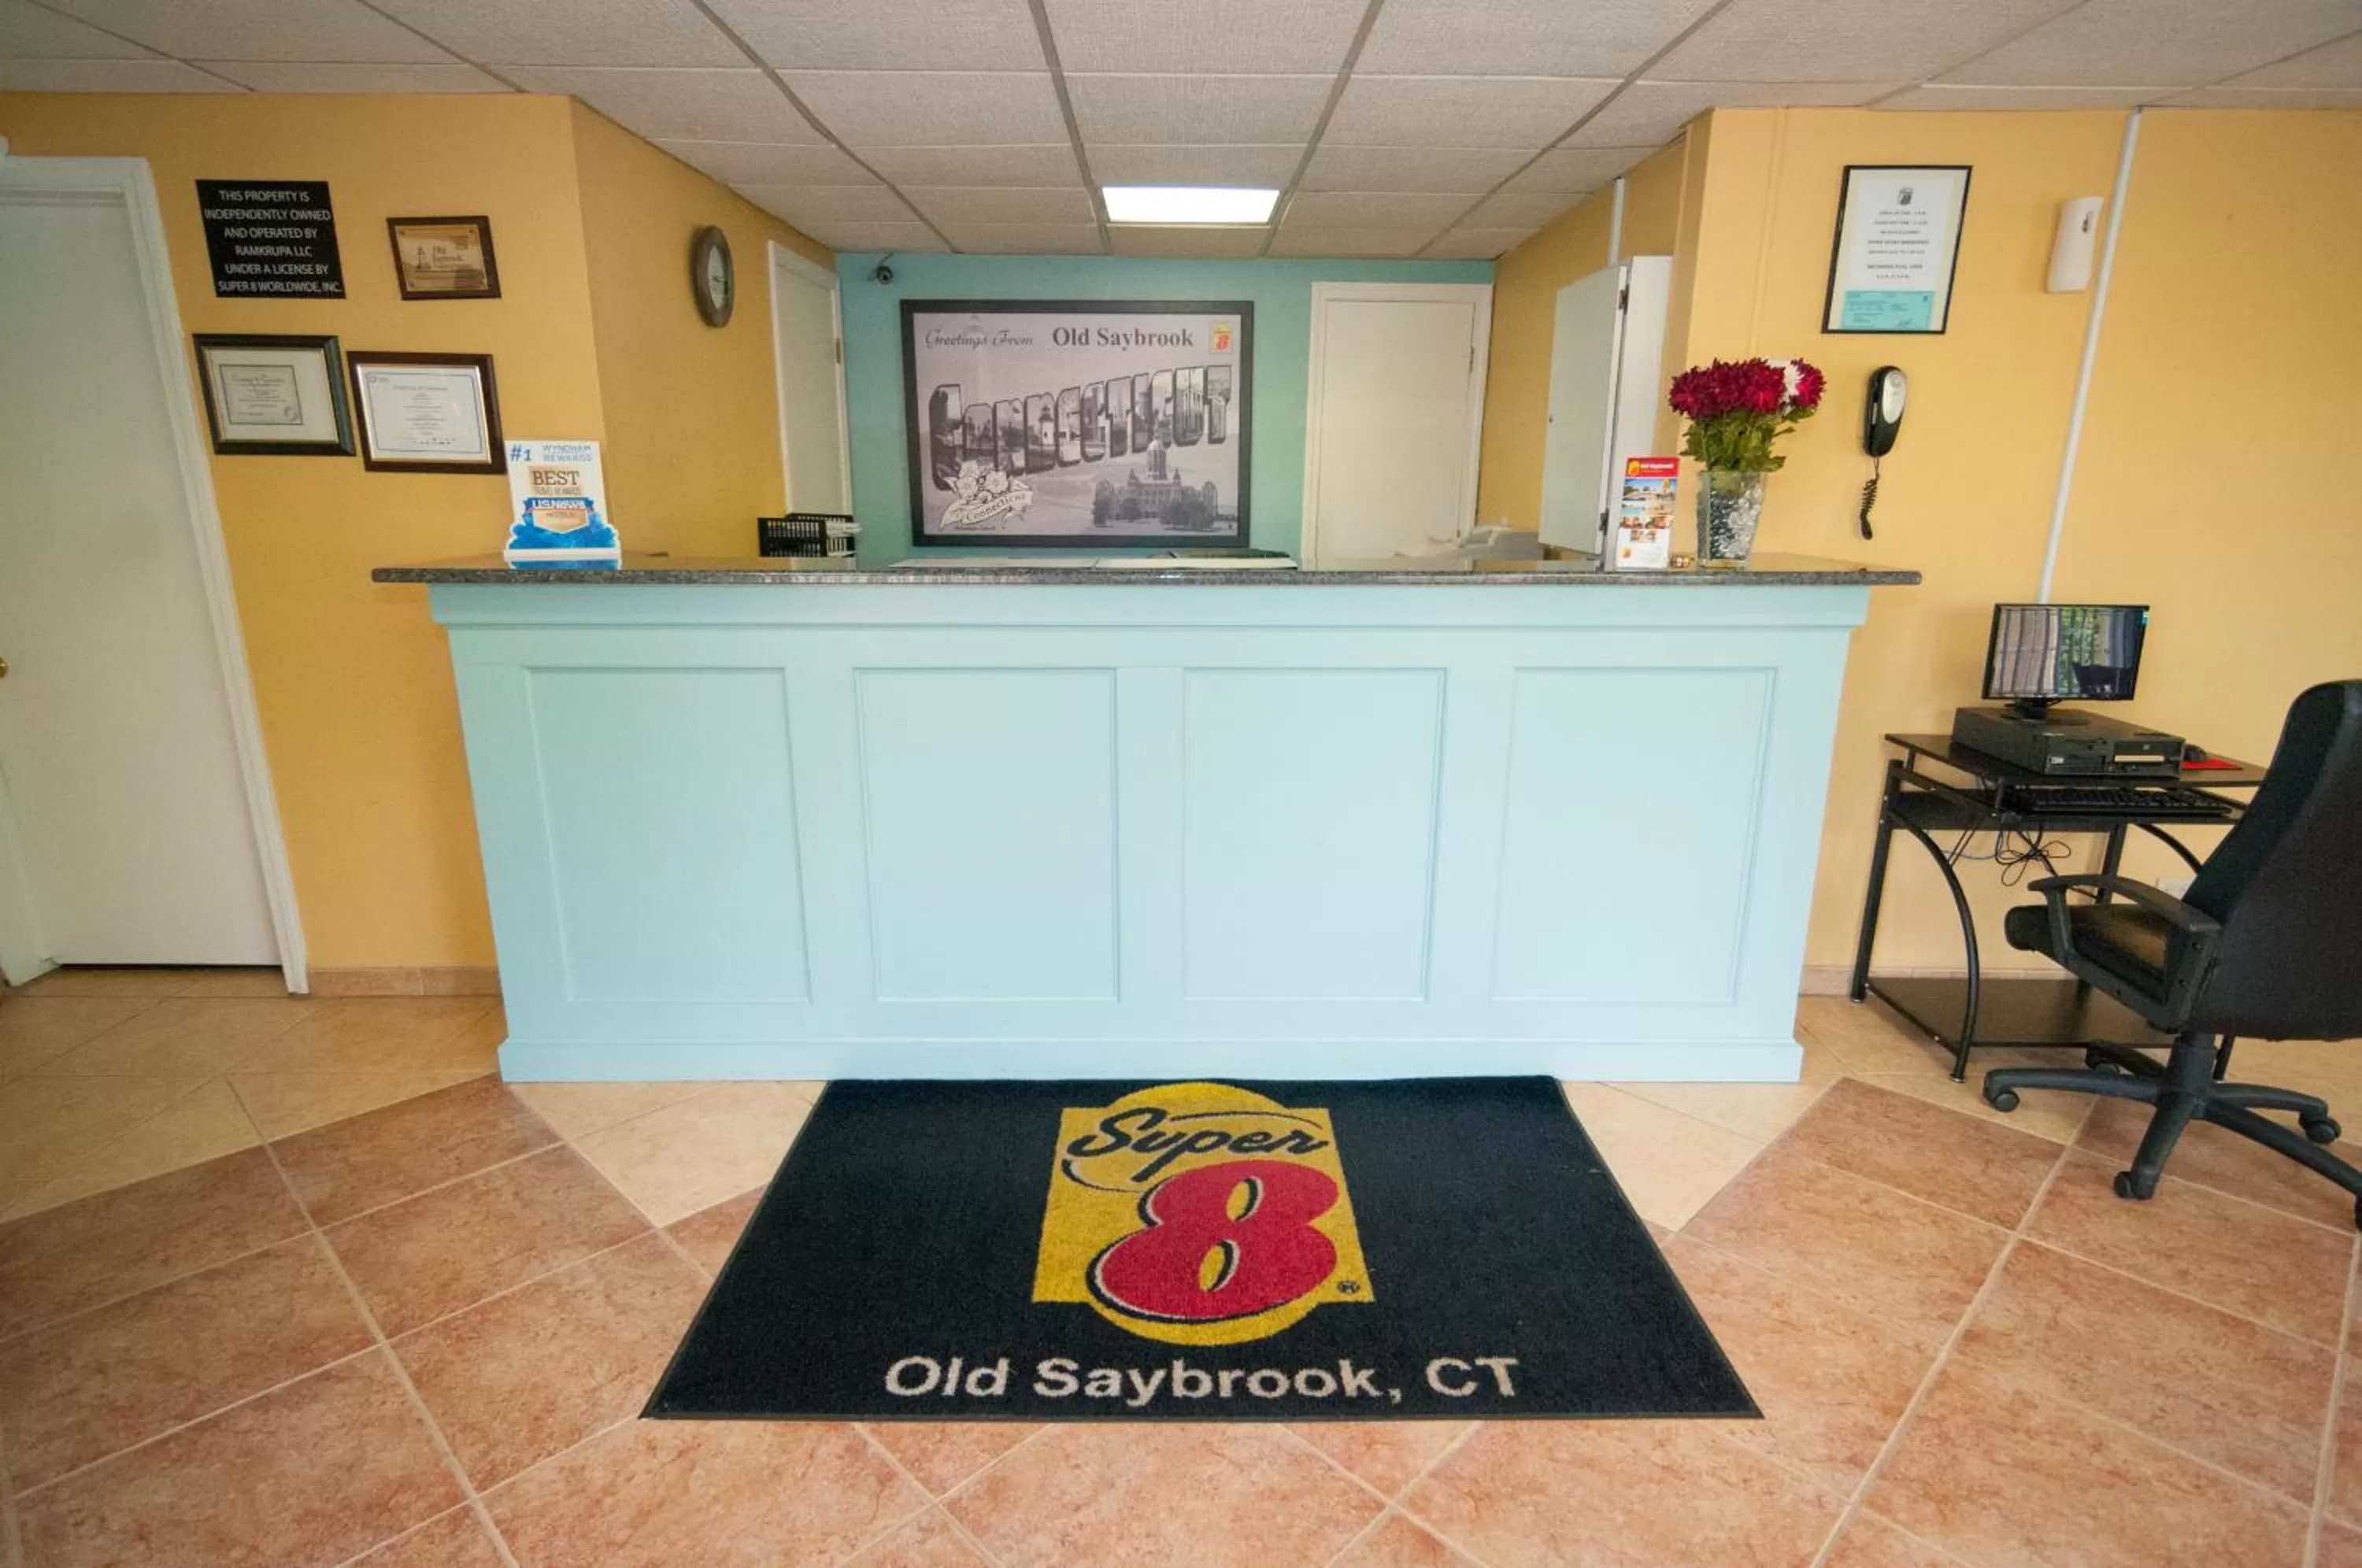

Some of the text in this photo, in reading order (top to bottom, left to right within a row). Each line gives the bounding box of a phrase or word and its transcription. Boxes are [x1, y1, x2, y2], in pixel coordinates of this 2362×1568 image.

[218, 190, 310, 202] THIS PROPERTY IS
[205, 209, 331, 221] INDEPENDENTLY OWNED
[224, 227, 318, 239] AND OPERATED BY
[294, 246, 313, 257] LLC
[224, 264, 328, 275] UNDER A LICENSE BY
[218, 280, 249, 291] SUPER
[925, 327, 1194, 351] Greetings From Old Saybrook
[510, 444, 531, 462] #1
[542, 444, 592, 454] WYNDHAM
[532, 471, 580, 486] BEST
[1067, 1108, 1329, 1183] Super
[1087, 1159, 1338, 1326] 8
[885, 1356, 1520, 1407] Old Saybrook, CT
